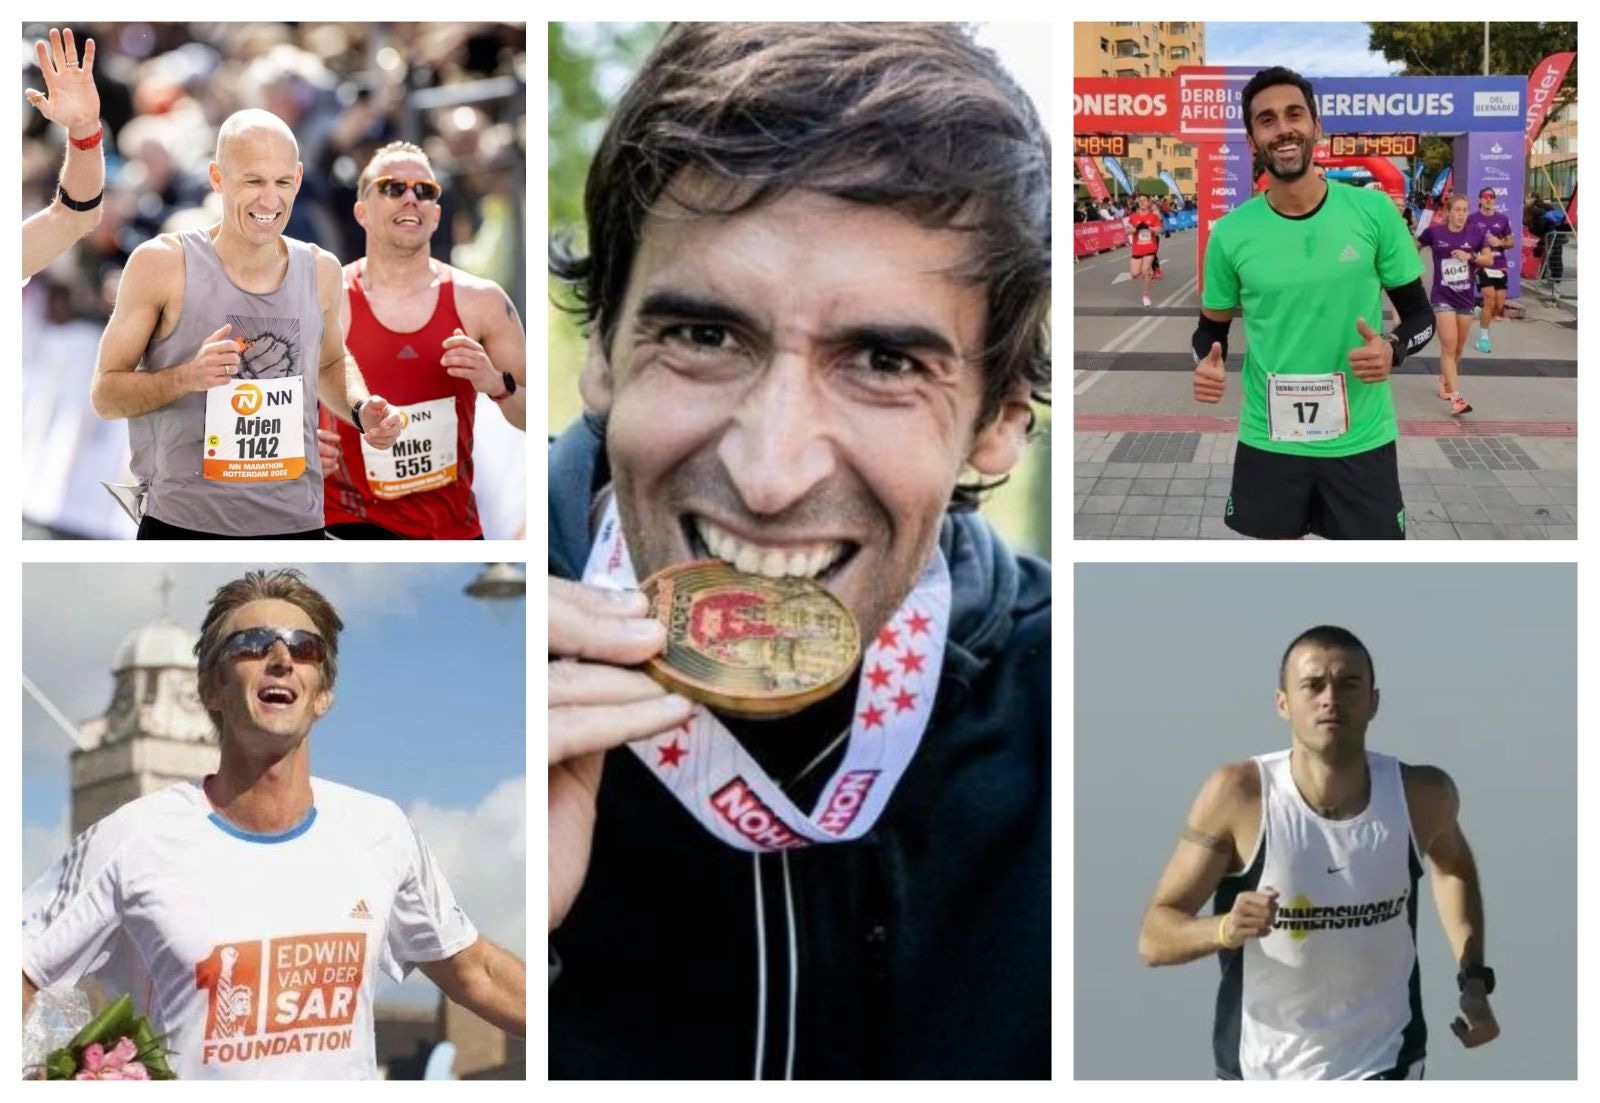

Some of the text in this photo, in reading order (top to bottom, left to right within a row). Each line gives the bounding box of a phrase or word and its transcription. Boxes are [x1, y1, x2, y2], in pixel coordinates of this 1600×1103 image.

[1181, 88, 1232, 103] DERBI
[1489, 96, 1504, 104] DEL
[1444, 265, 1467, 276] 4047
[266, 389, 292, 406] NN
[411, 410, 431, 422] NN
[1292, 401, 1319, 424] 17
[234, 416, 281, 437] Arjen
[236, 436, 280, 459] 1142
[392, 438, 432, 458] Mike
[222, 469, 289, 478] ROTTERDAM 2022
[243, 462, 284, 470] MARATHON
[395, 454, 432, 479] 555
[277, 941, 360, 969] EDWIN
[278, 966, 358, 989] VAN DER
[274, 986, 354, 1025] SAR
[202, 1029, 352, 1065] FOUNDATION
